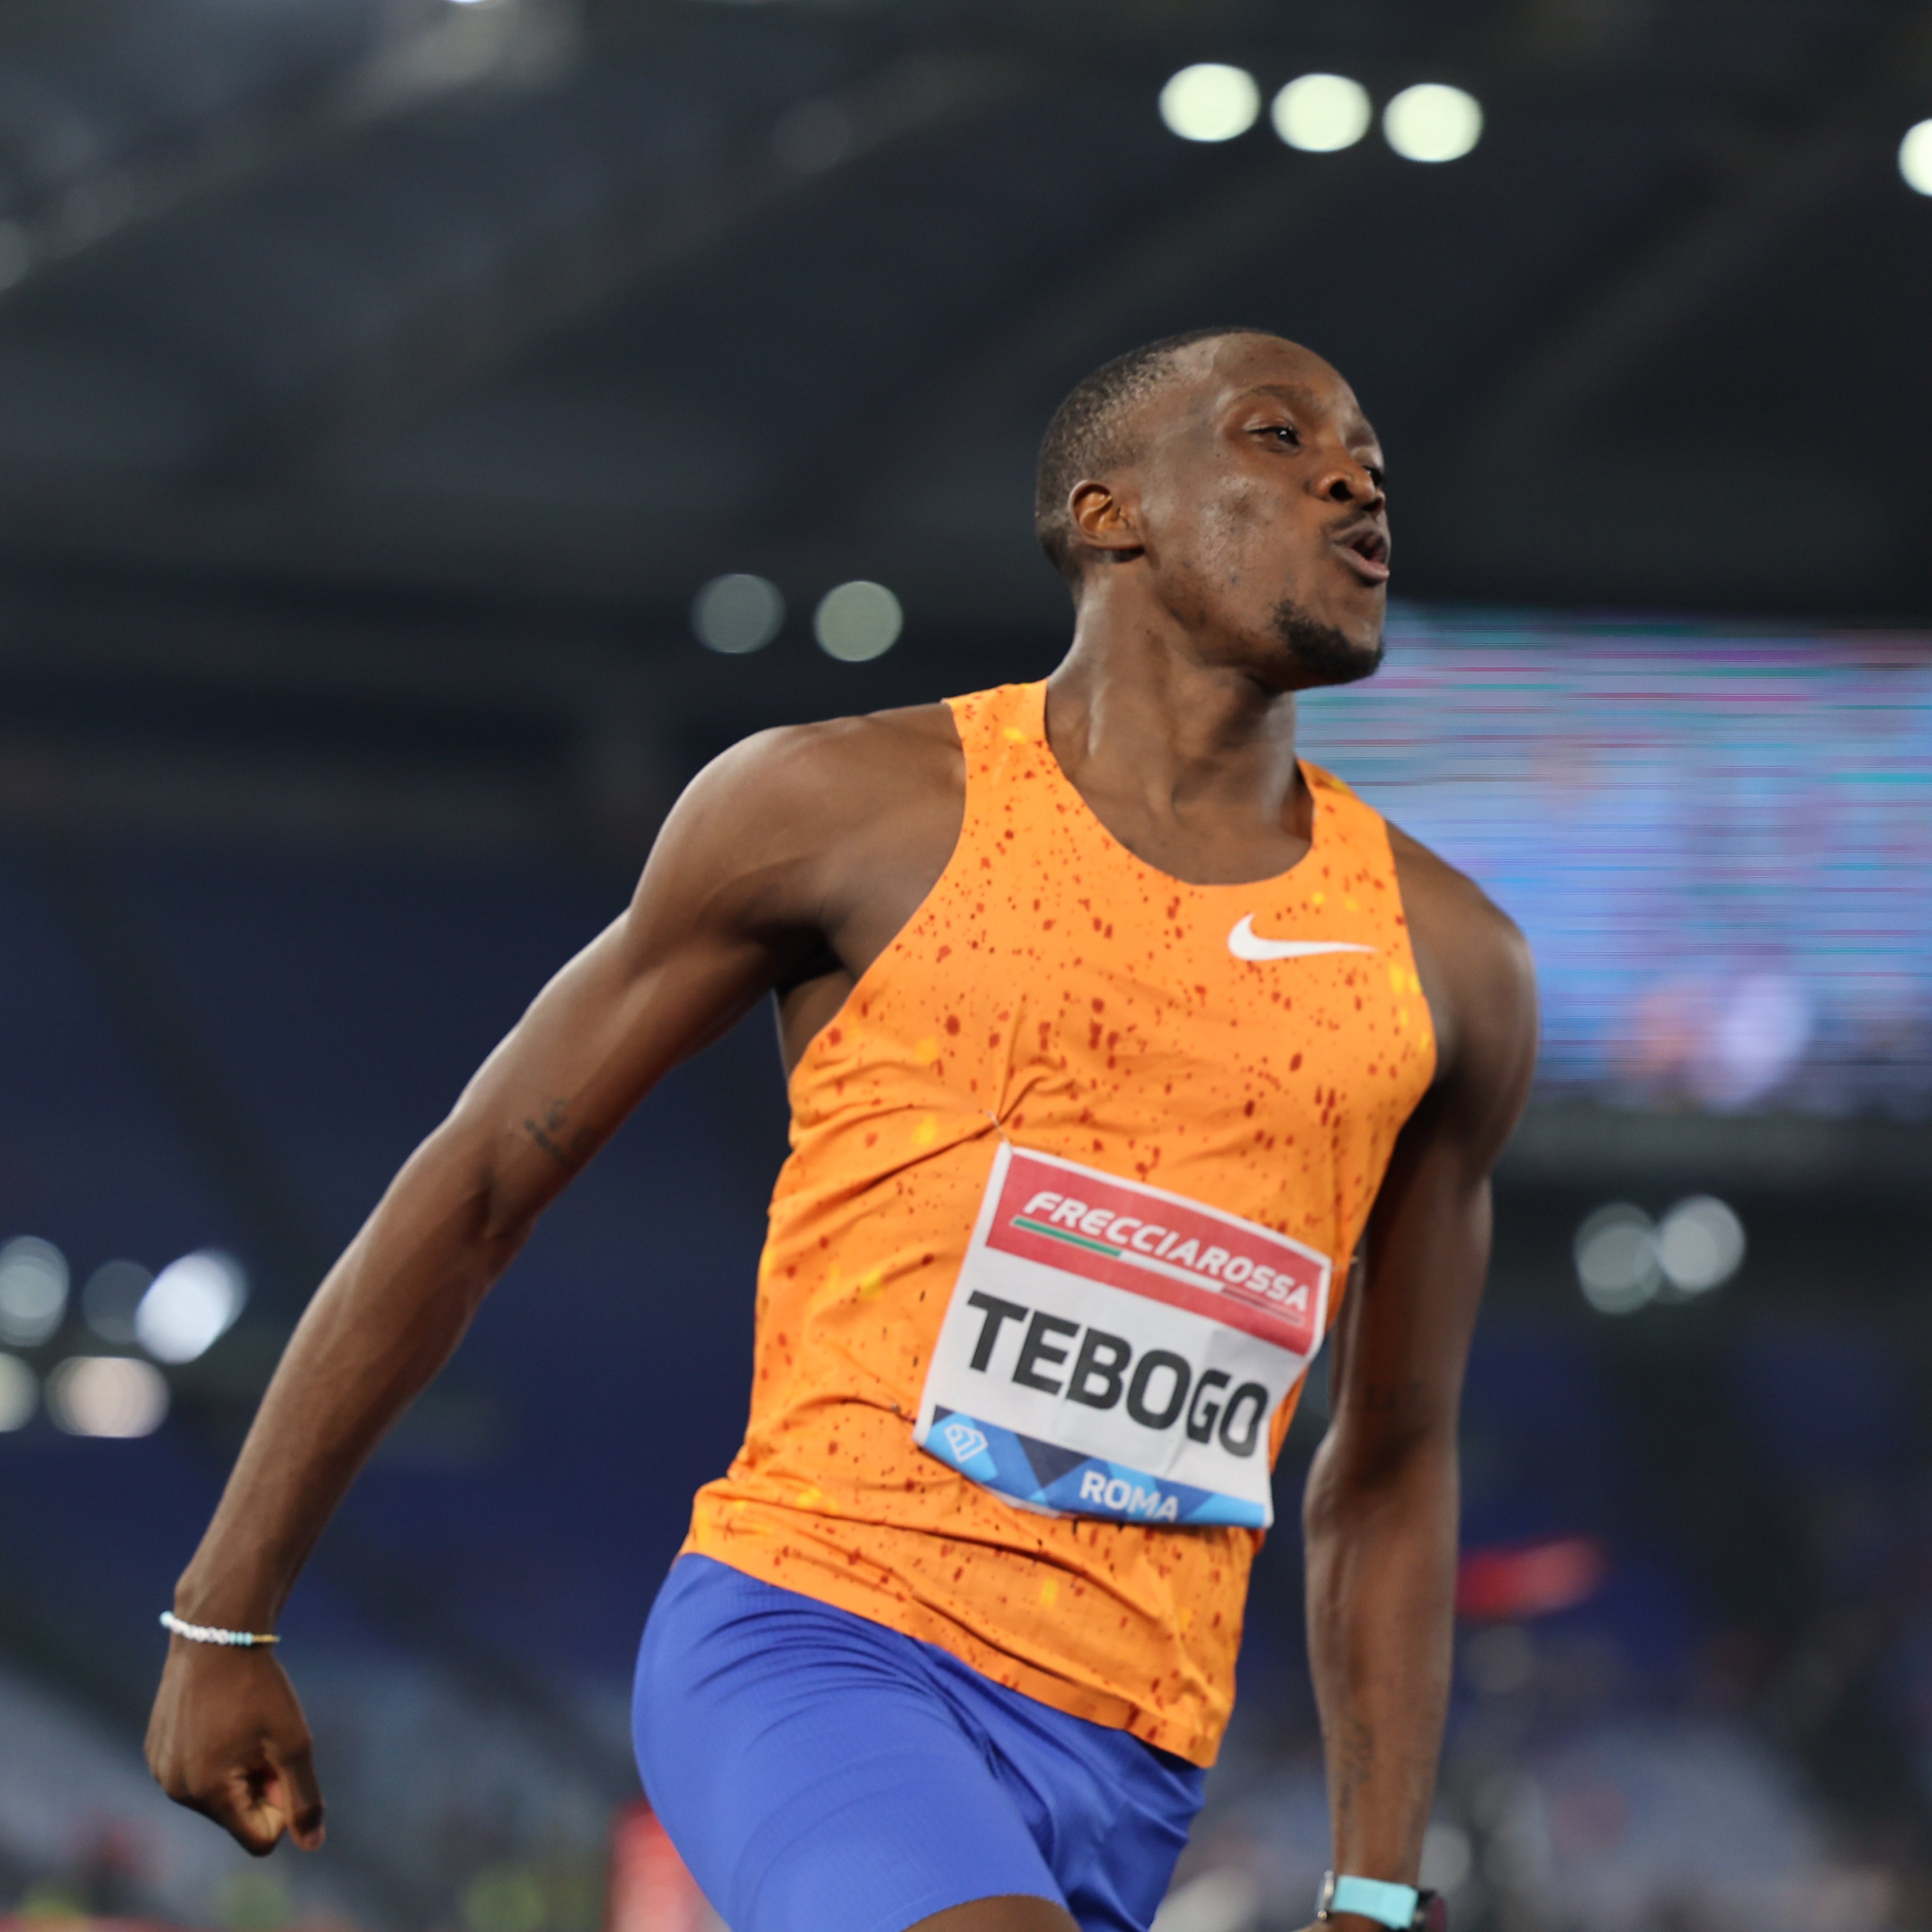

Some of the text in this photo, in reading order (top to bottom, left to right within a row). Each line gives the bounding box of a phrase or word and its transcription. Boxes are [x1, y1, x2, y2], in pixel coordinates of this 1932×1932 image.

[1024, 1191, 1307, 1311] FRECCIAROSSA
[967, 1290, 1269, 1458] TEBOGO
[1079, 1471, 1179, 1522] ROMA
